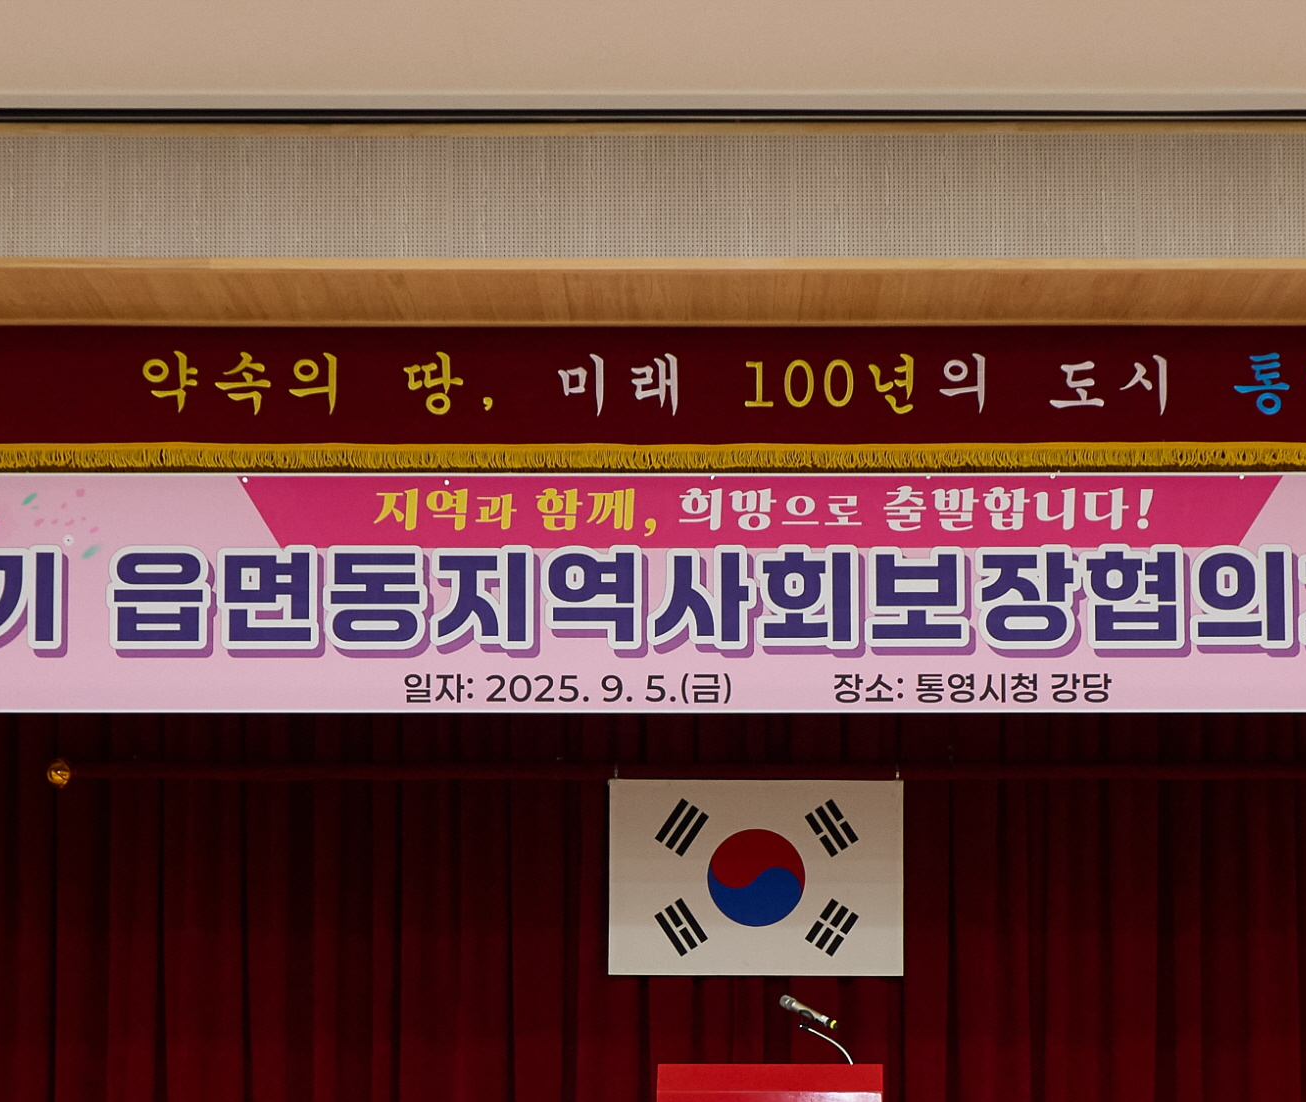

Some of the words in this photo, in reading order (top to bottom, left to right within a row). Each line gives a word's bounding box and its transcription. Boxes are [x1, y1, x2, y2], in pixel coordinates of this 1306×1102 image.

[142, 351, 339, 416] 약속의
[404, 352, 494, 417] 땅,
[559, 353, 681, 418] 미래
[745, 353, 987, 416] 100년의
[1050, 355, 1169, 416] 도시
[374, 488, 518, 532] 지역과
[536, 488, 658, 538] 함께,
[679, 488, 863, 532] 희망으로
[884, 486, 1155, 533] 출발합니다!
[404, 673, 475, 705] 일자:
[486, 675, 591, 704] 2025.
[601, 675, 634, 704] 9.
[645, 674, 733, 706] 5.(금)
[833, 673, 905, 705] 장소:
[915, 673, 1040, 705] 통영시청
[1051, 673, 1113, 705] 강당
